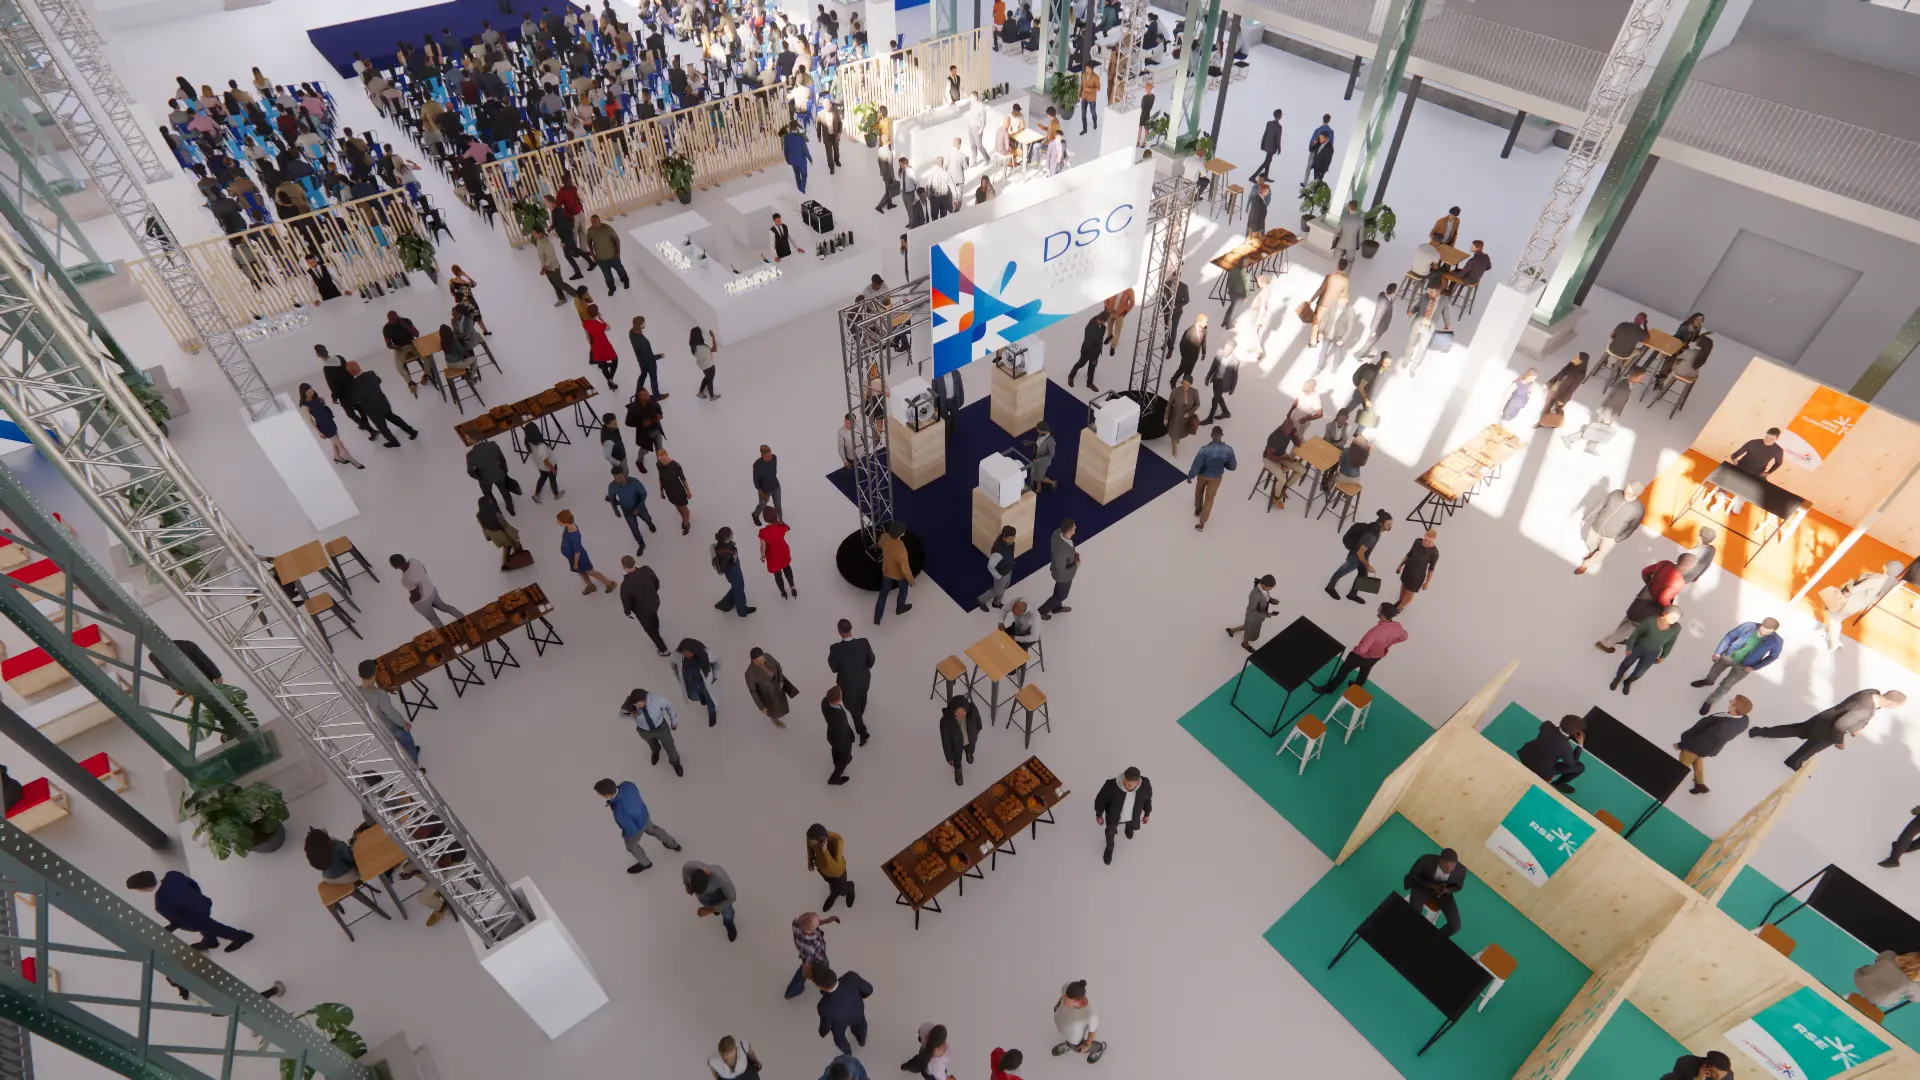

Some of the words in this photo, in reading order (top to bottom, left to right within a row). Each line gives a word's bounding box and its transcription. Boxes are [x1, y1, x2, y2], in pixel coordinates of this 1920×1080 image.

[1043, 204, 1133, 262] DSC
[1043, 231, 1130, 274] DISTRIBON
[1529, 820, 1555, 842] RSE
[1792, 1023, 1829, 1050] RSE
